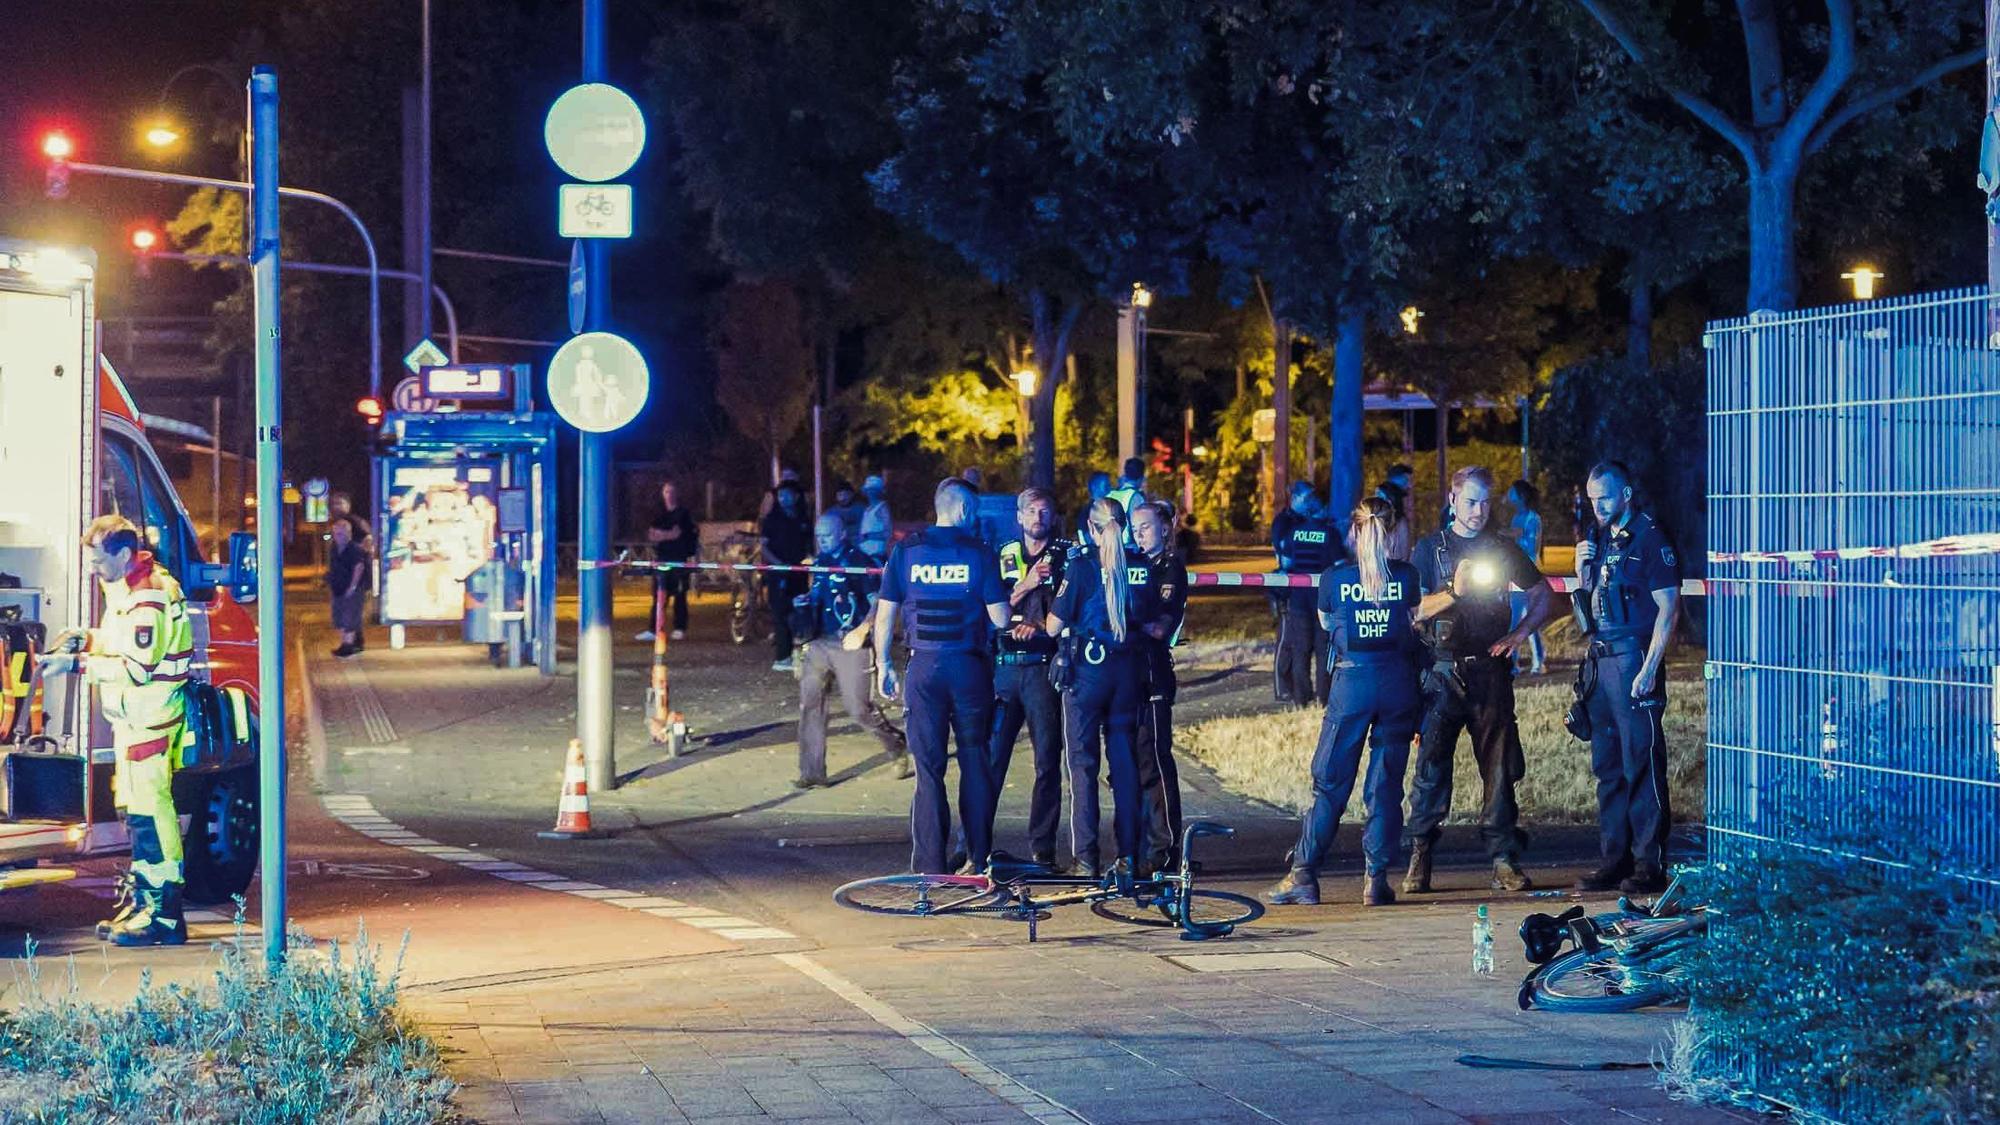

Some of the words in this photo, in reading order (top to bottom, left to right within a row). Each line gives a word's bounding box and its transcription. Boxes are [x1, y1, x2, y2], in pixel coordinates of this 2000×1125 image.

[1293, 529, 1326, 544] POLIZEI
[910, 564, 969, 584] POLIZEI
[1340, 581, 1403, 603] POLZEI
[1354, 608, 1390, 623] NRW
[1359, 624, 1388, 638] DHF
